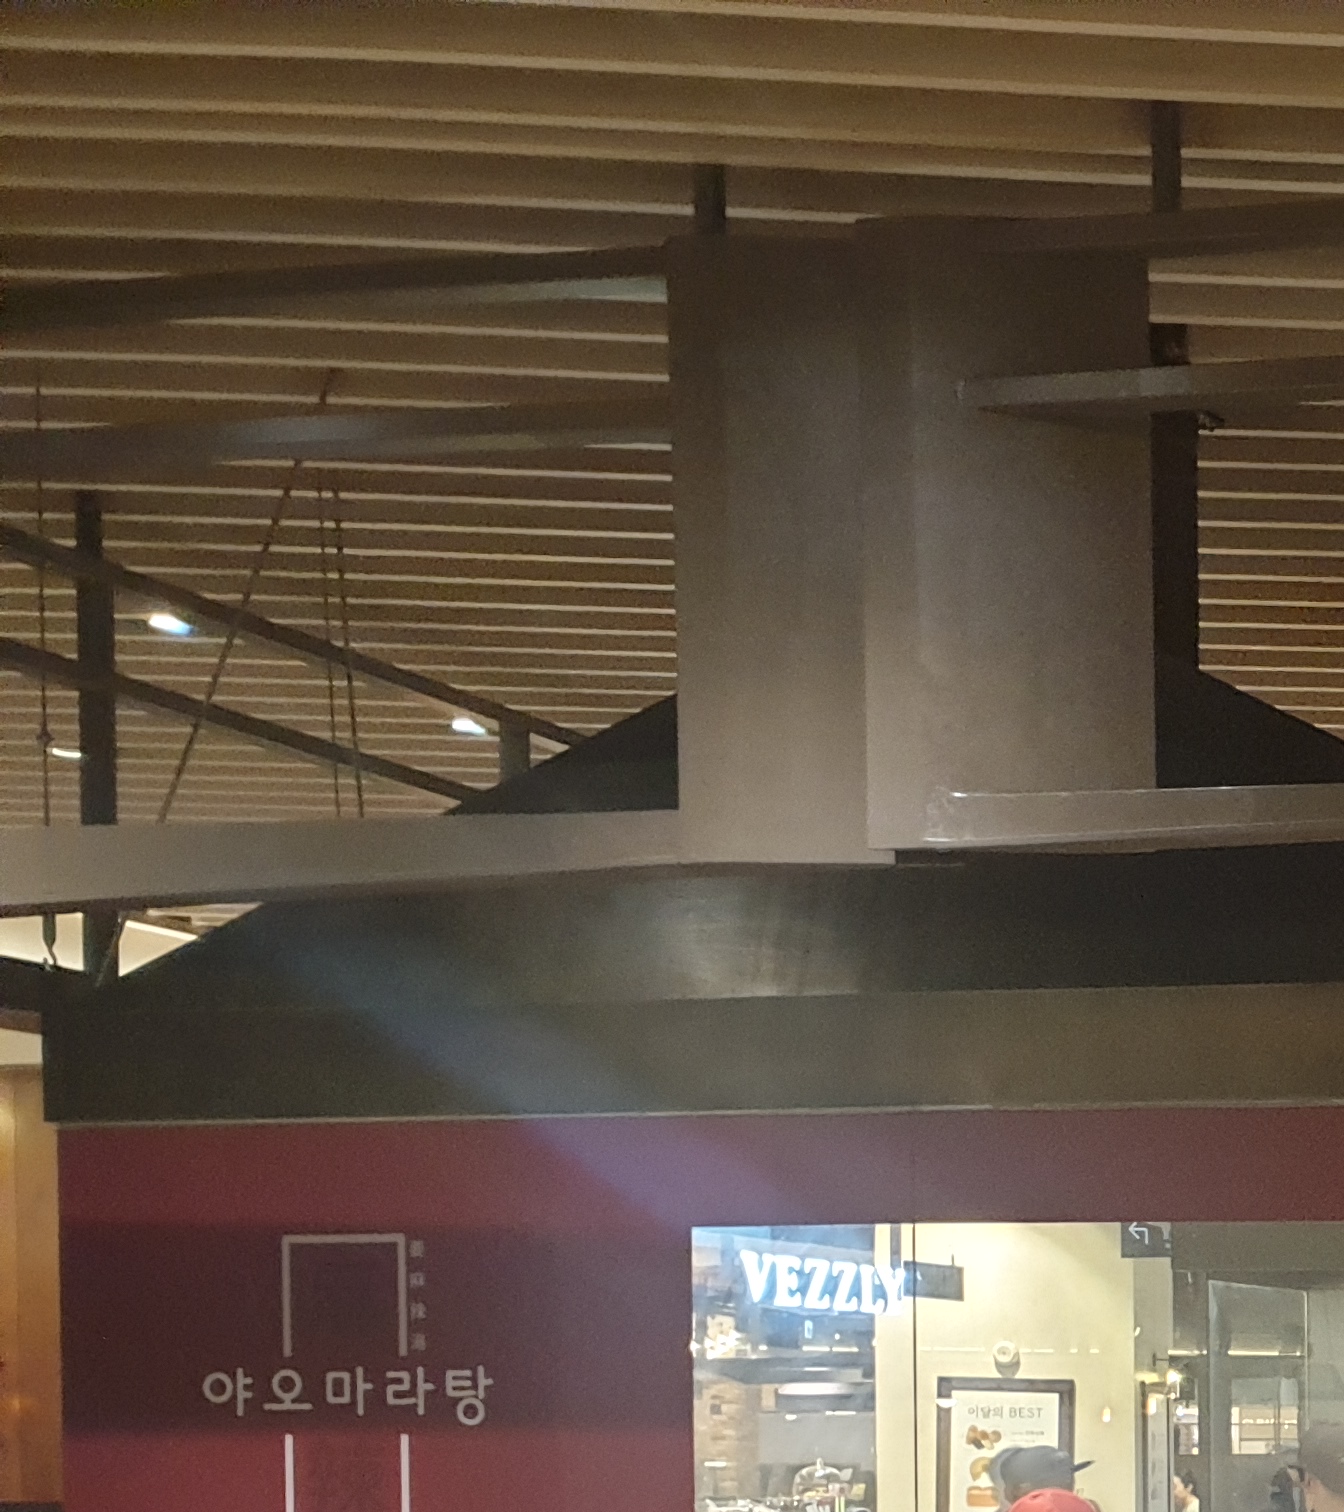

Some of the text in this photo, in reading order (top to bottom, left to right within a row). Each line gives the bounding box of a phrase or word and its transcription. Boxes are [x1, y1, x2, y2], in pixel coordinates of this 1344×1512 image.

[740, 1249, 905, 1316] VEZZLY
[202, 1365, 494, 1426] 야오마라탕
[967, 1405, 1043, 1419] 이달의 BEST
